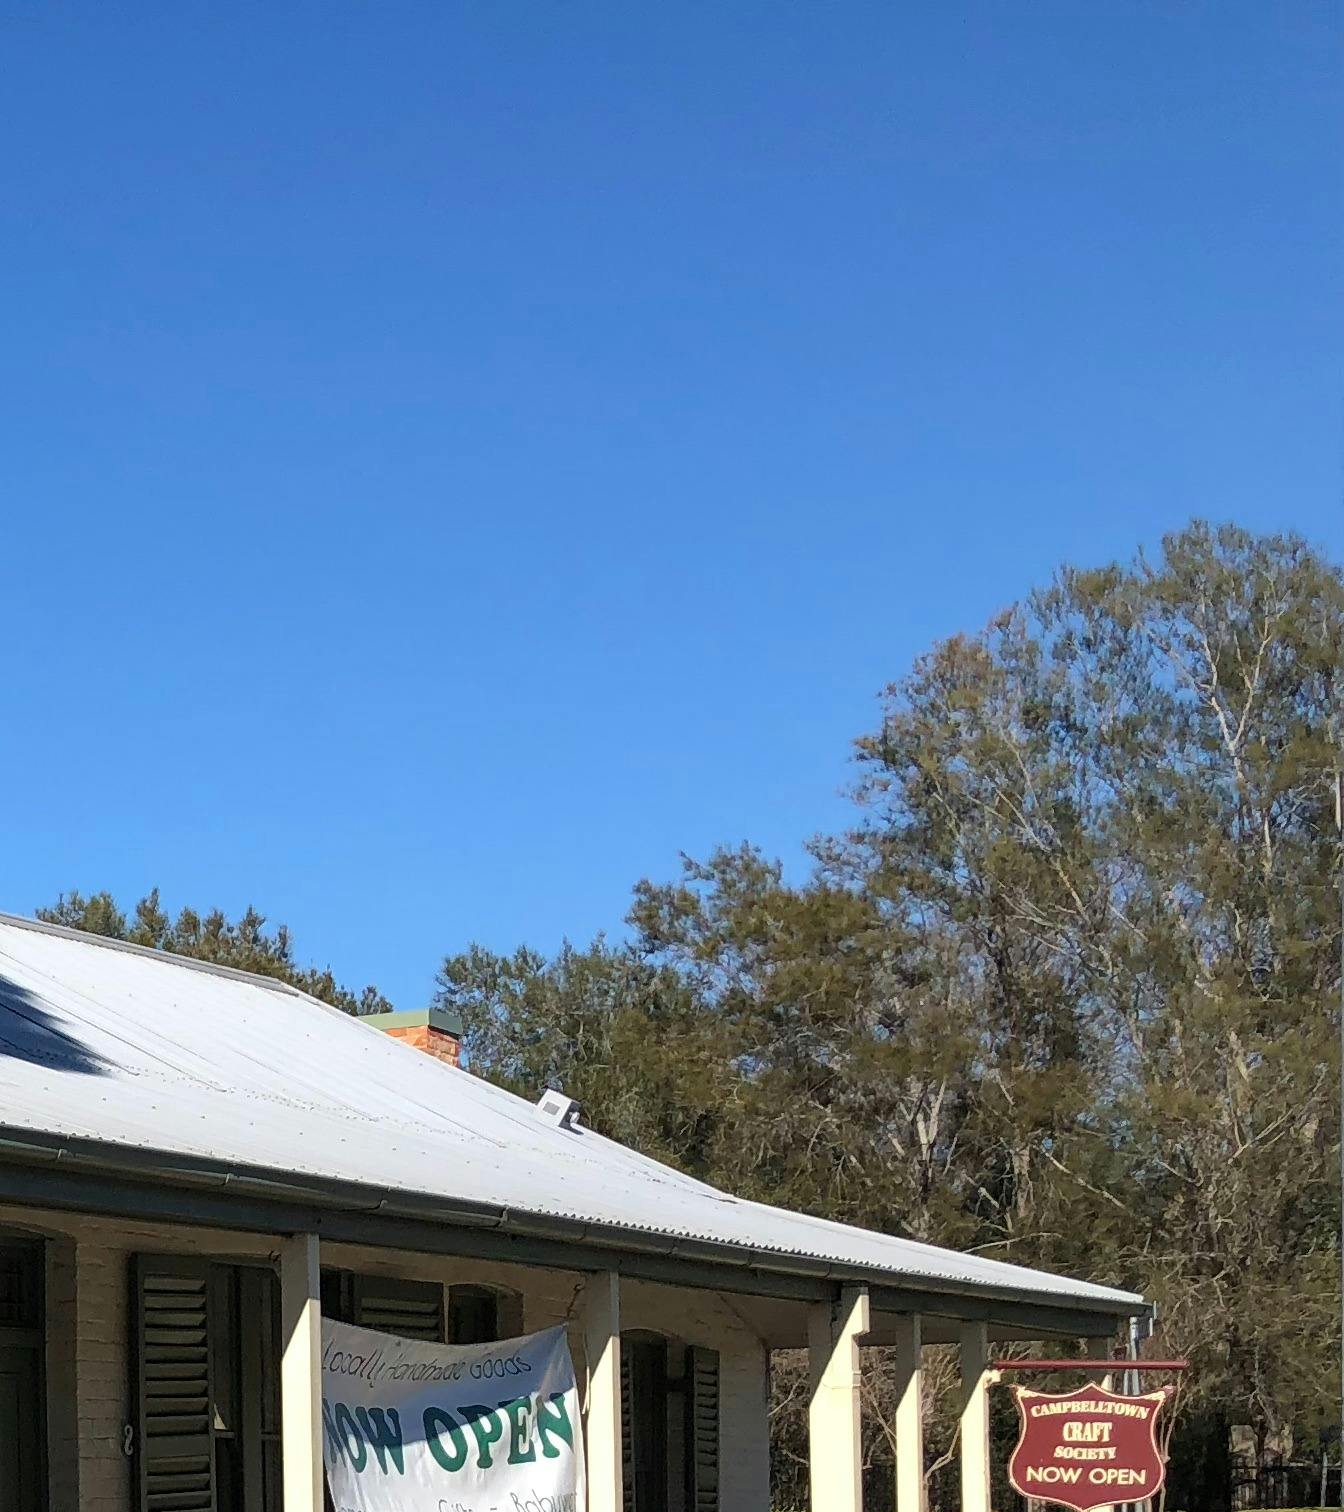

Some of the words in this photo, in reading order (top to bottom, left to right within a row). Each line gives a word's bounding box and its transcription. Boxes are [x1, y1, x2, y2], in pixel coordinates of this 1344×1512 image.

[1030, 1400, 1151, 1420] CAMPBELLTOWN
[321, 1397, 405, 1476] NOW
[423, 1392, 574, 1473] OPEN
[1062, 1421, 1113, 1443] CRAFT
[1053, 1445, 1117, 1461] SOCIETY
[1026, 1466, 1083, 1484] NOW
[1088, 1468, 1147, 1486] OPEN
